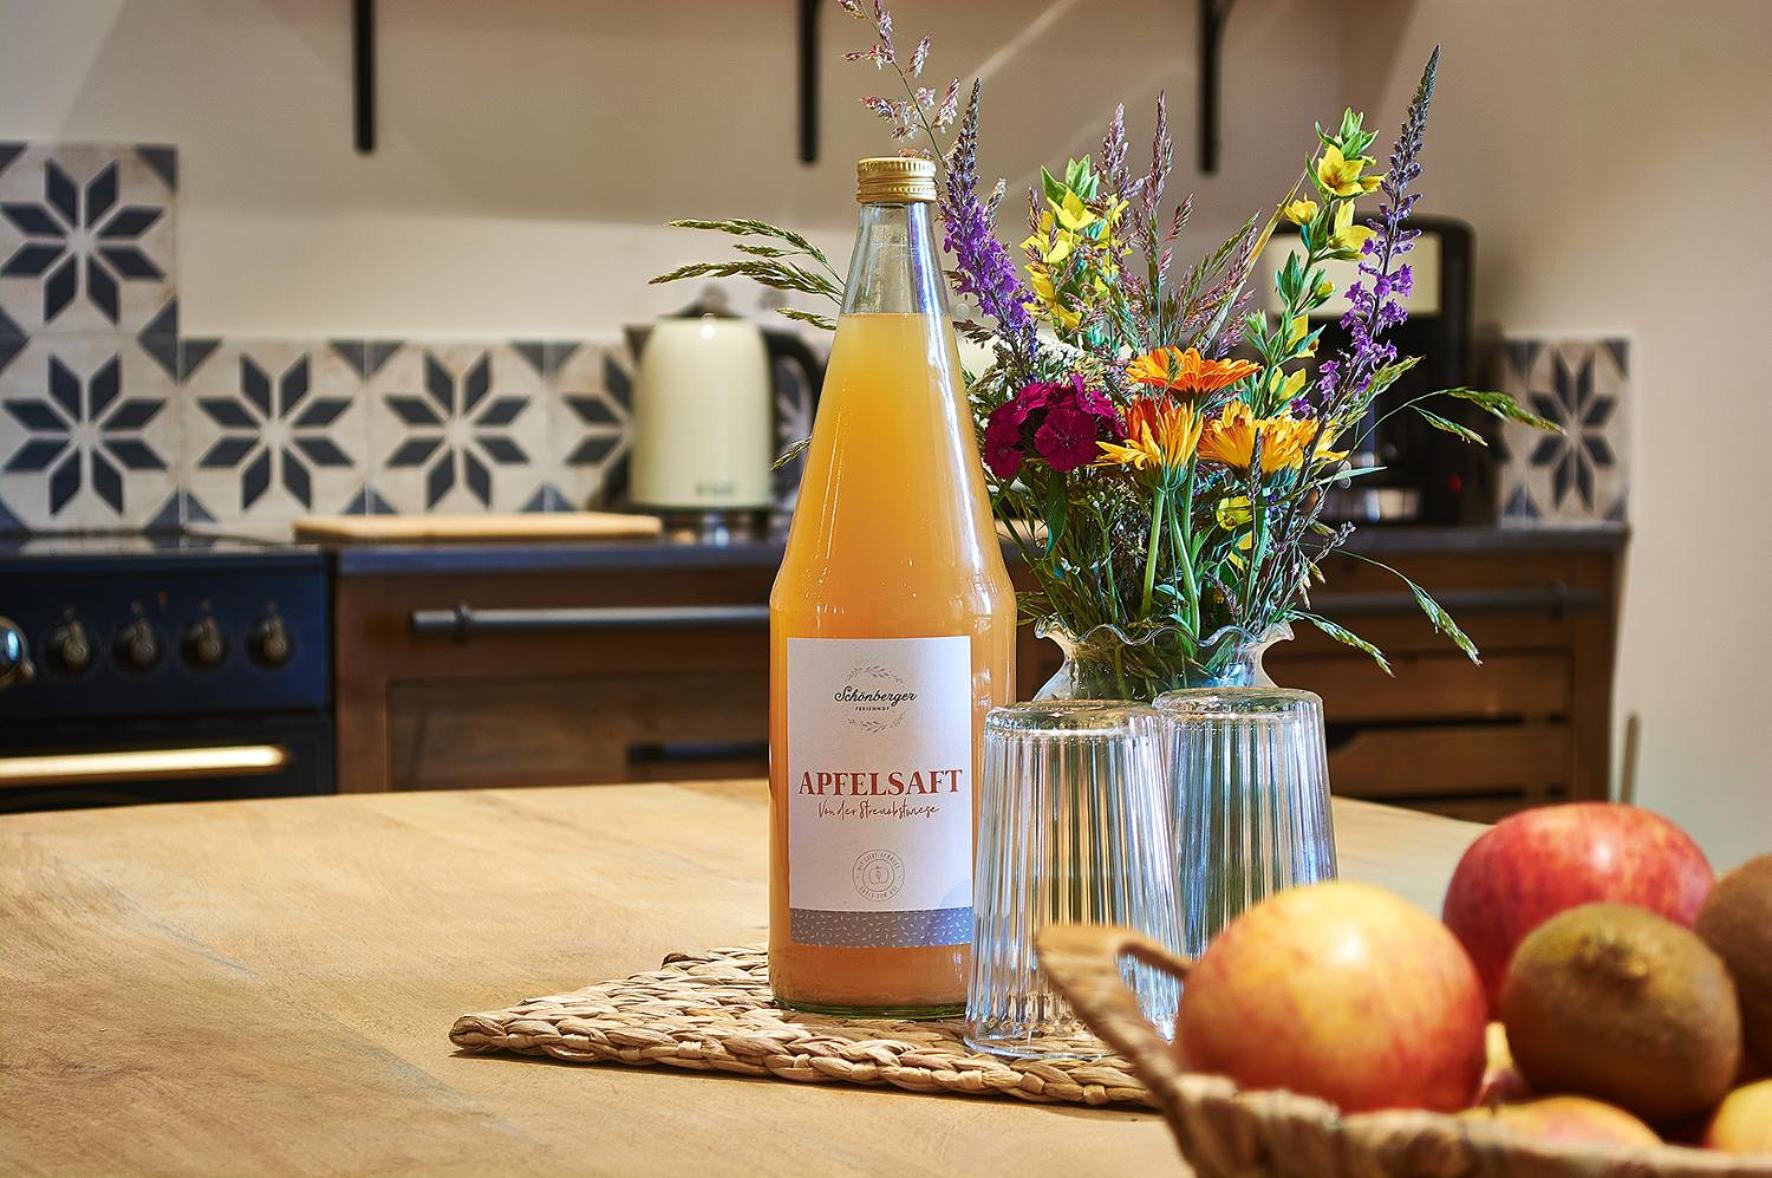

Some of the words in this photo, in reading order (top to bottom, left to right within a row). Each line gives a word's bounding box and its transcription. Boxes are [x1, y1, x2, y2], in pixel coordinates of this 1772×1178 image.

[834, 685, 917, 707] Schönberger
[799, 769, 963, 796] APFELSAFT
[818, 799, 836, 819] Von
[837, 799, 857, 821] der
